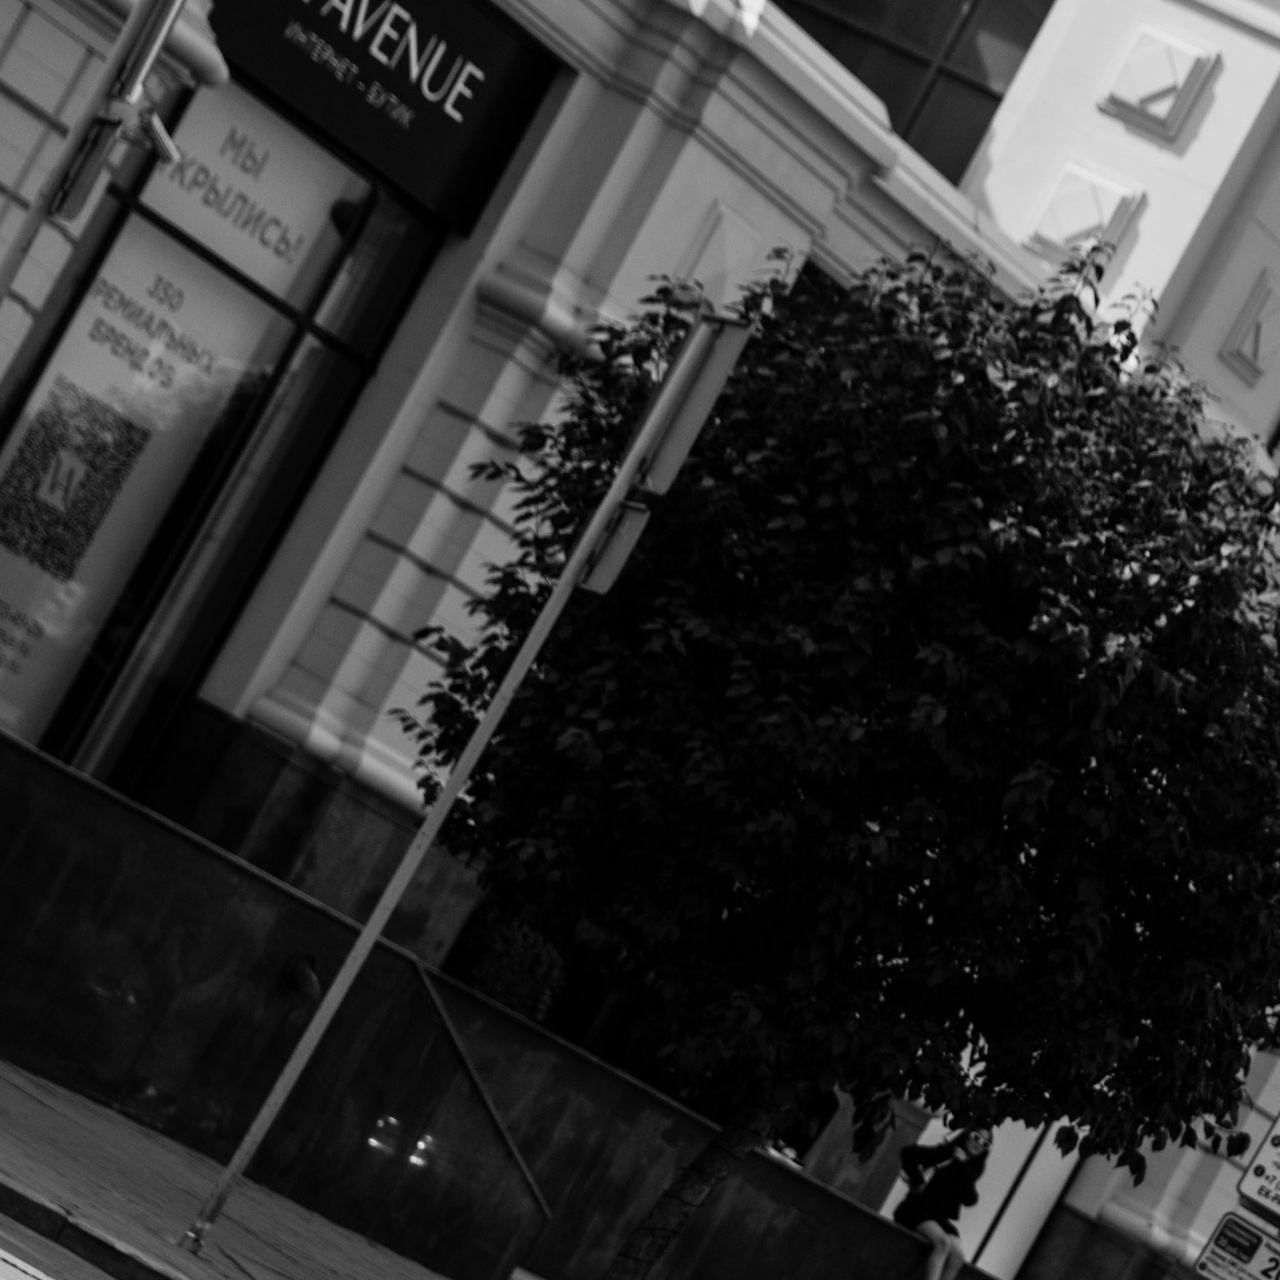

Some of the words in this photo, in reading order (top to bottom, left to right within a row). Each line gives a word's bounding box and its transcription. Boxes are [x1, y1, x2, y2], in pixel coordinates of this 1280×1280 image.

[283, 18, 360, 86] ИНТЕРНЕТ
[365, 80, 415, 130] БУТИК
[319, 0, 486, 123] AVENUE
[219, 125, 271, 181] МЫ
